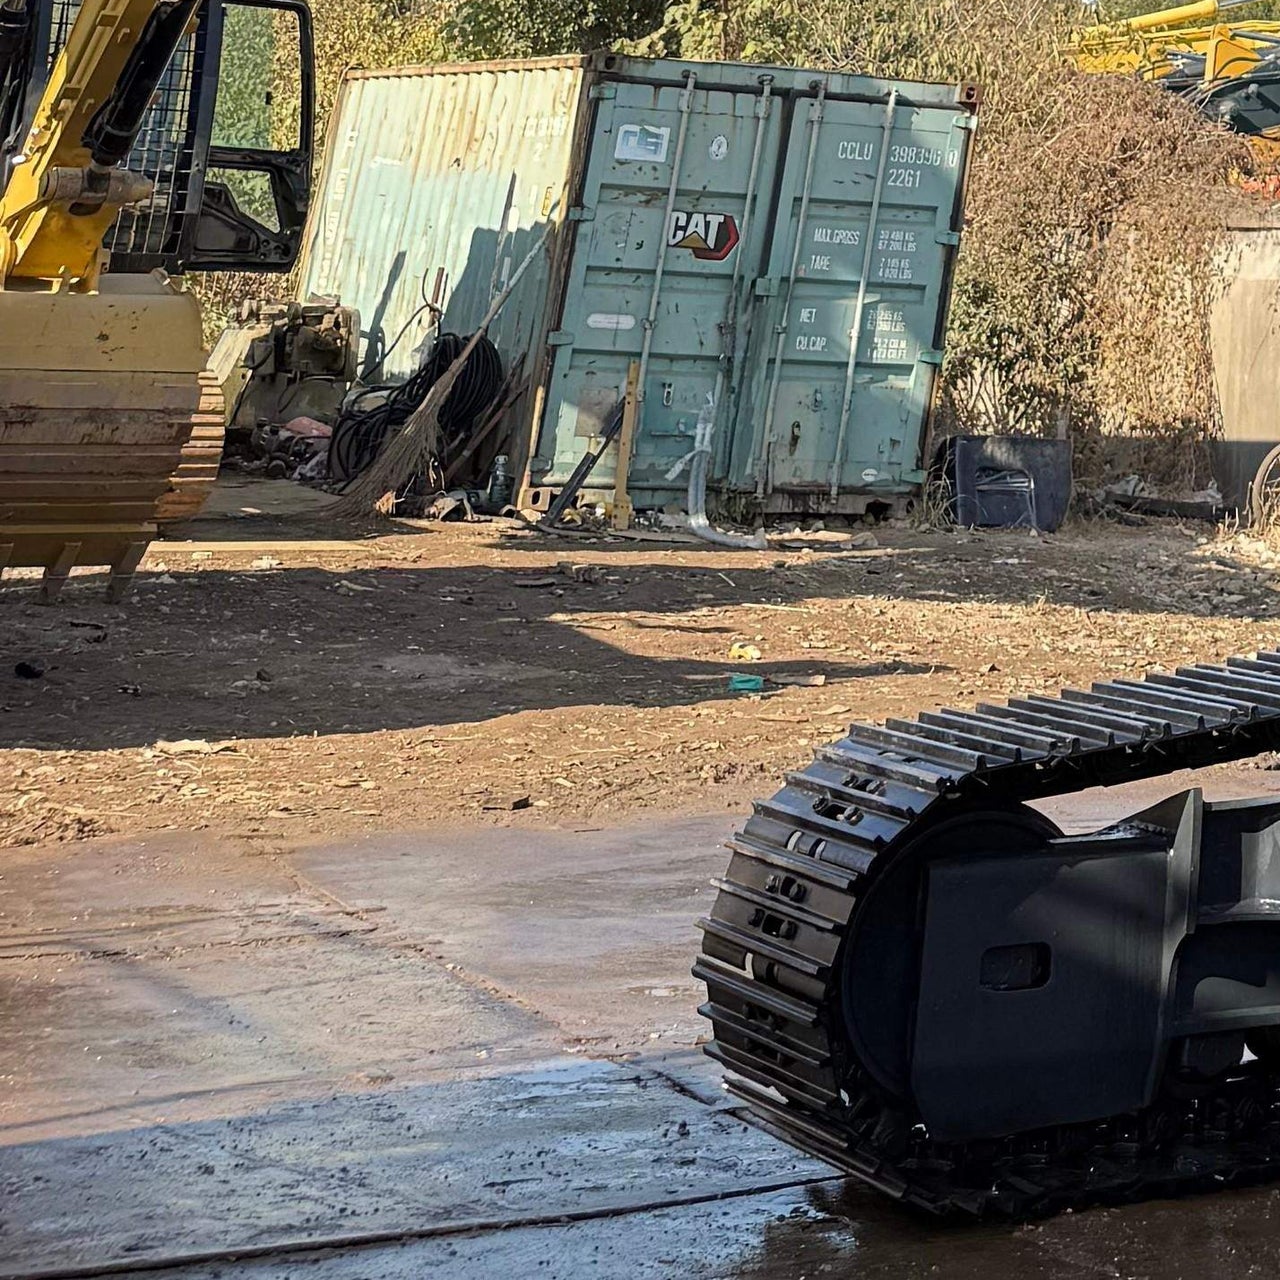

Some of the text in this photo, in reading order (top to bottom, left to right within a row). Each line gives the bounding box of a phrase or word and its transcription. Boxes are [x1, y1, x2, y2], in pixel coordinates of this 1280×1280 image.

[838, 141, 873, 161] CCLU
[887, 168, 921, 188] 22G1
[668, 211, 725, 250] CAT
